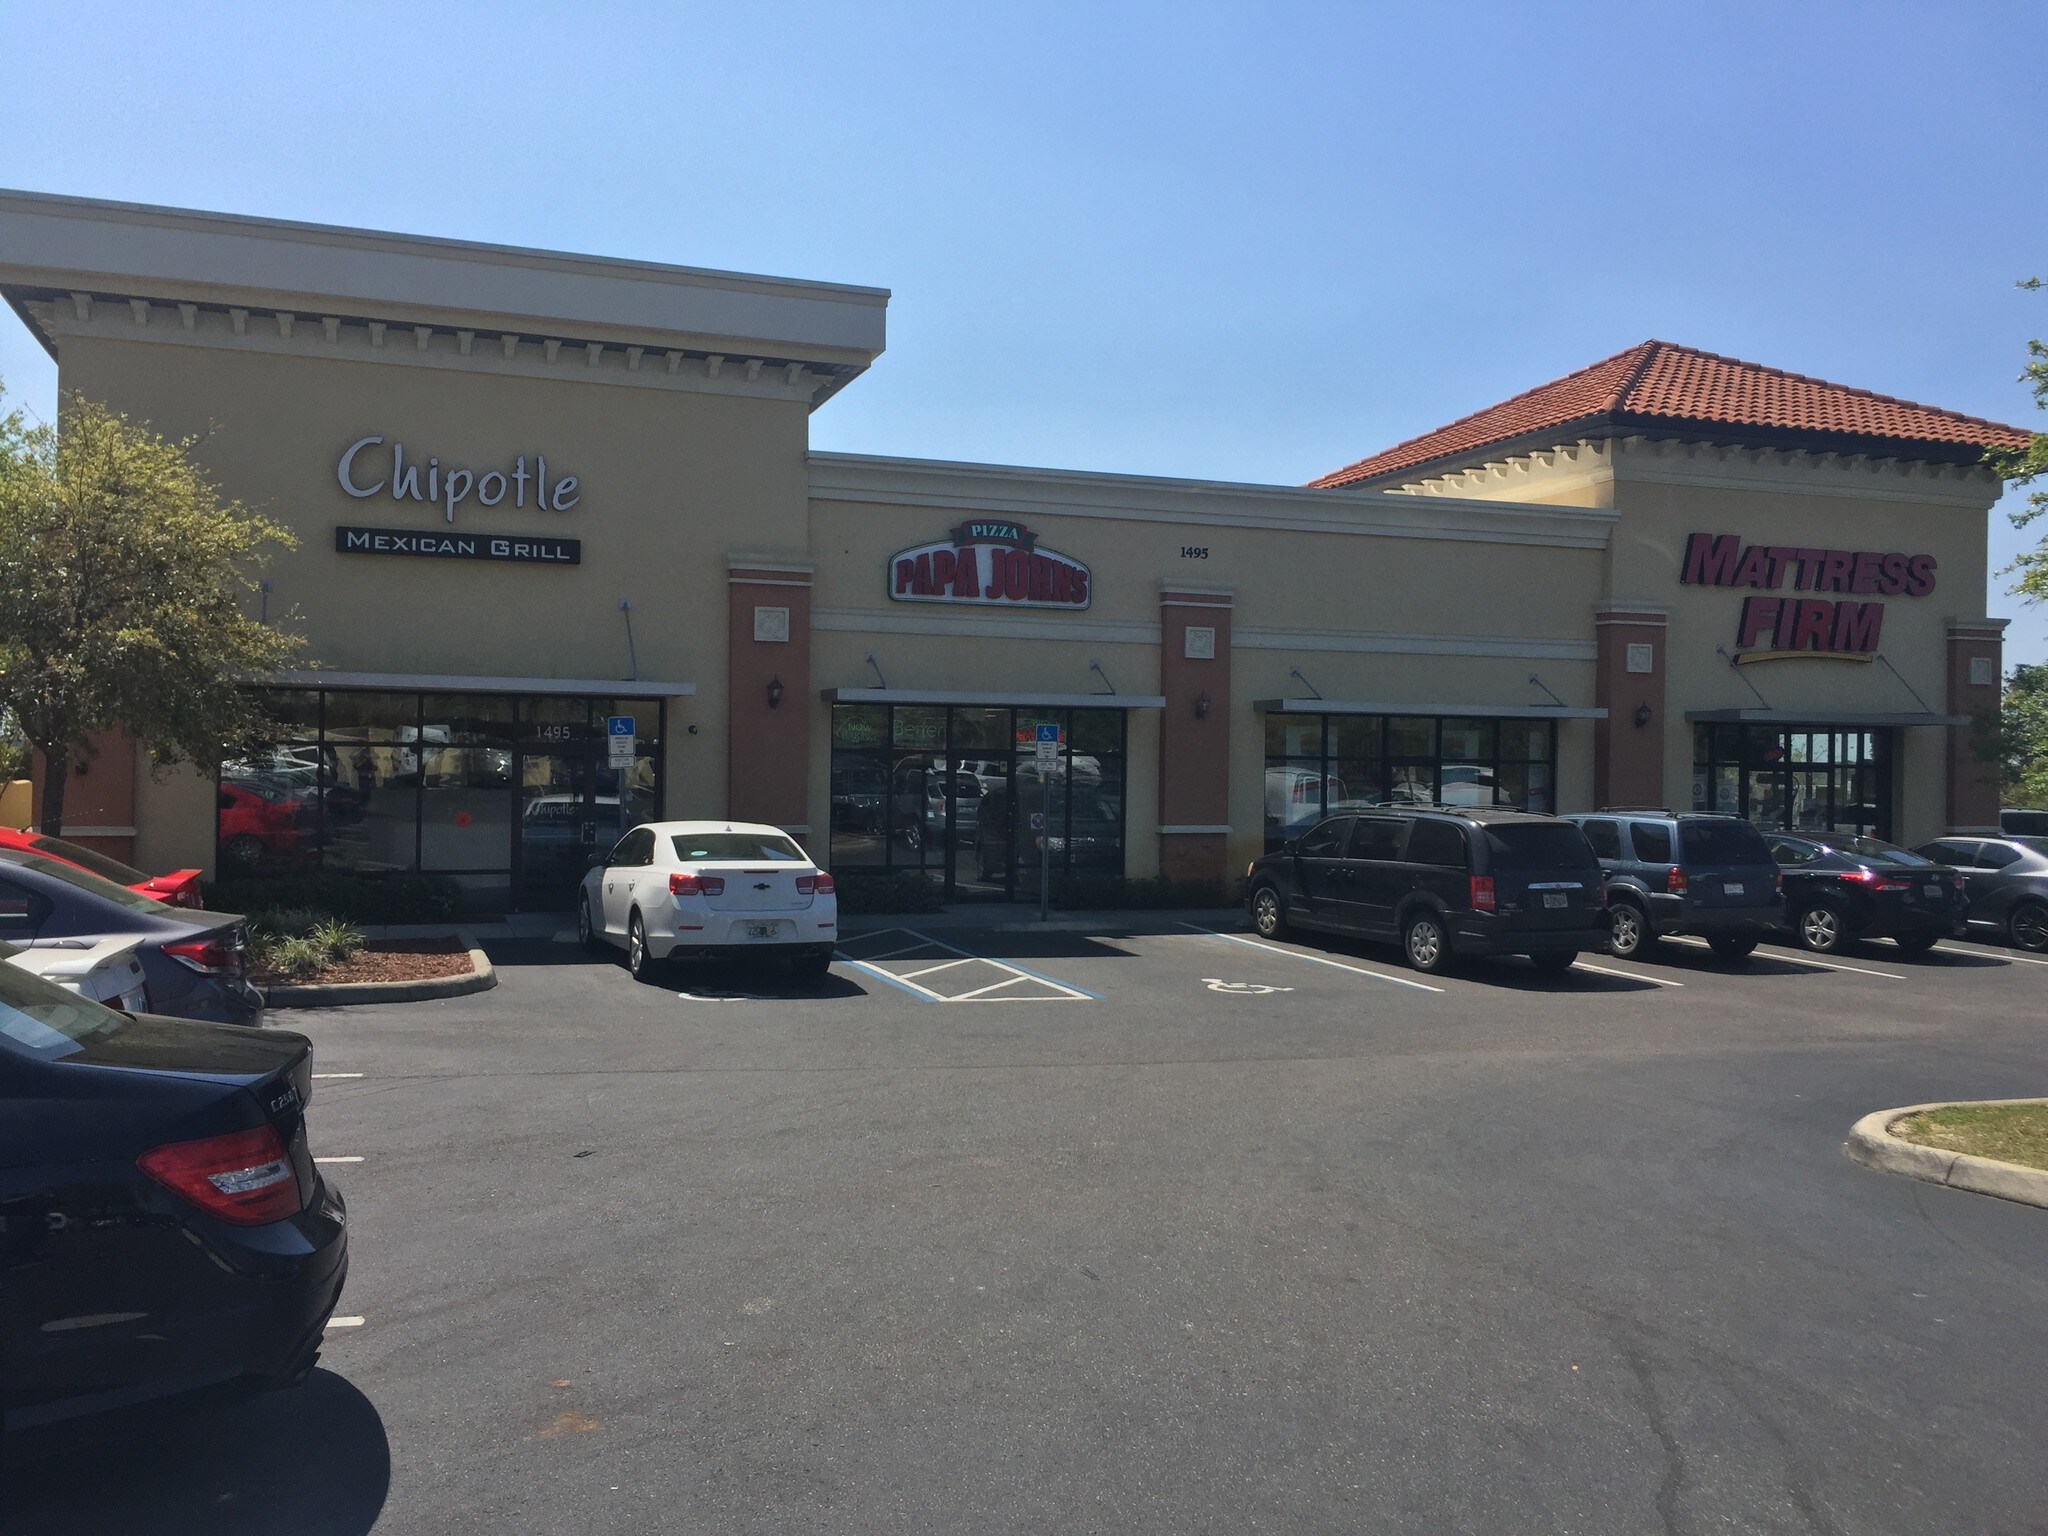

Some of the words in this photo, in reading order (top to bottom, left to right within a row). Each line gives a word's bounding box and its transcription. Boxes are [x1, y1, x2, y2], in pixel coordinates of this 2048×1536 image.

[337, 436, 581, 523] Chipotle
[347, 531, 475, 555] MEXICAN
[490, 539, 571, 560] GRILL
[970, 524, 1020, 540] PIZZA
[1180, 546, 1209, 560] 1495
[895, 547, 980, 598] PAPA
[985, 548, 1088, 604] JOHN'S
[1680, 533, 1938, 597] MATTRESS
[1736, 596, 1885, 652] FIRM
[536, 725, 571, 740] 1495
